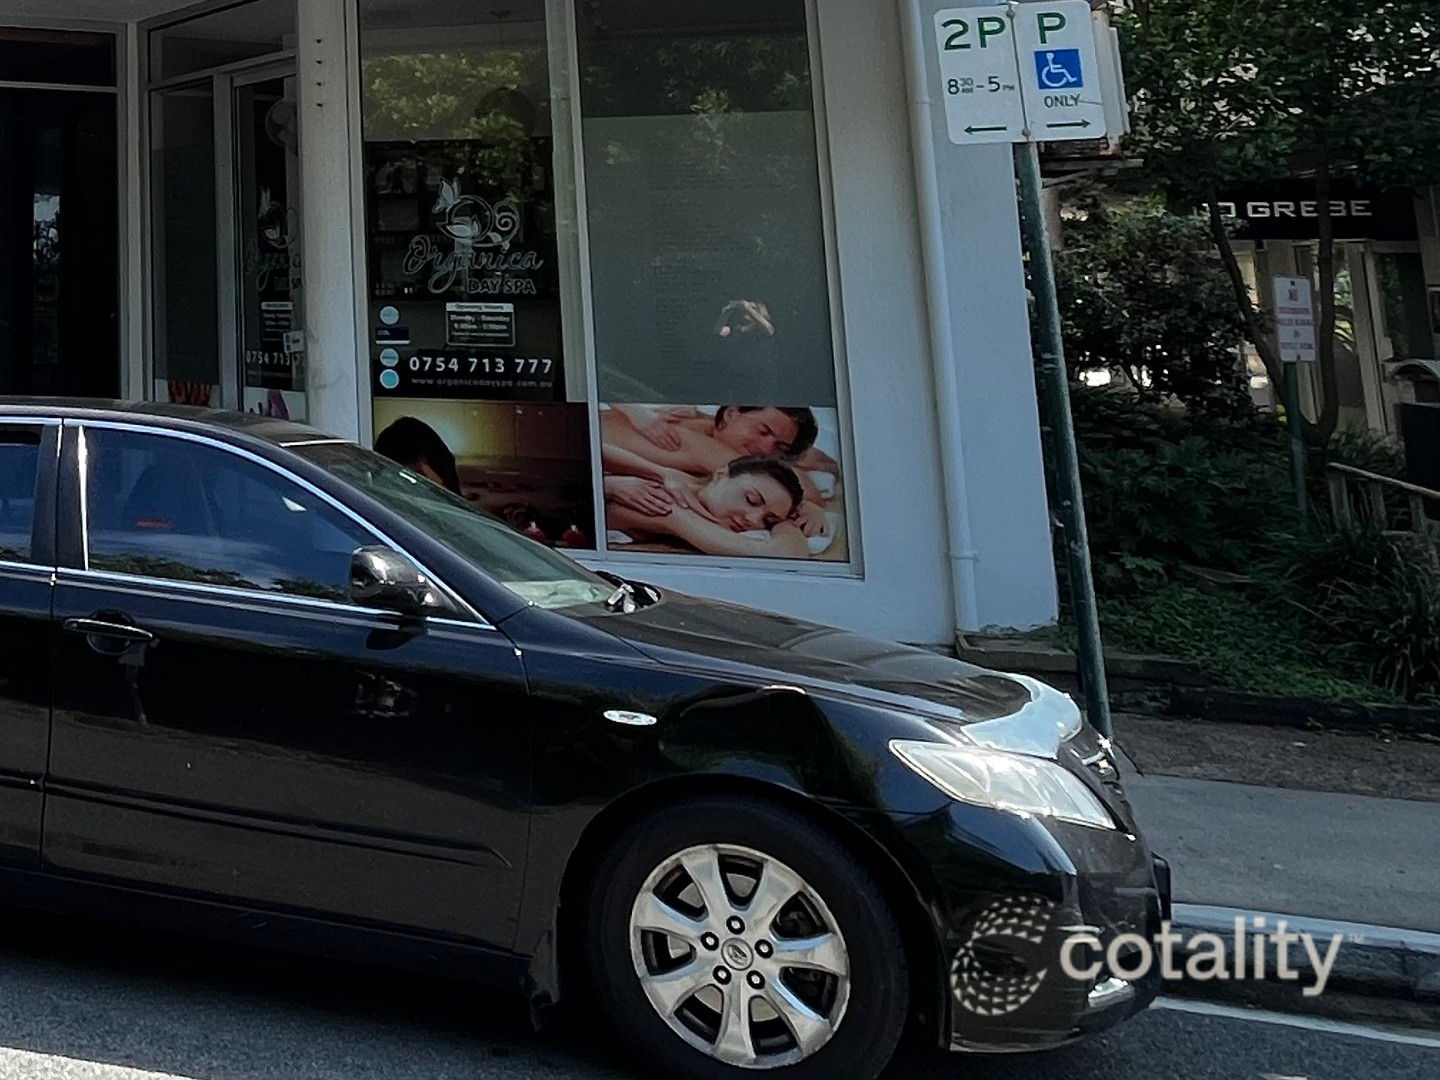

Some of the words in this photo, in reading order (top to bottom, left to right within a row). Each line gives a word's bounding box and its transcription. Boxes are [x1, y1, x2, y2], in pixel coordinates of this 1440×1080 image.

[941, 16, 1006, 51] 2P
[1037, 12, 1066, 44] P
[988, 75, 1000, 92] 5
[1044, 94, 1081, 108] ONLY
[403, 234, 545, 295] Organica
[468, 278, 504, 294] DAY
[505, 278, 537, 295] SPA
[409, 356, 459, 373] 0754
[468, 358, 505, 373] 713
[514, 358, 553, 374] 777
